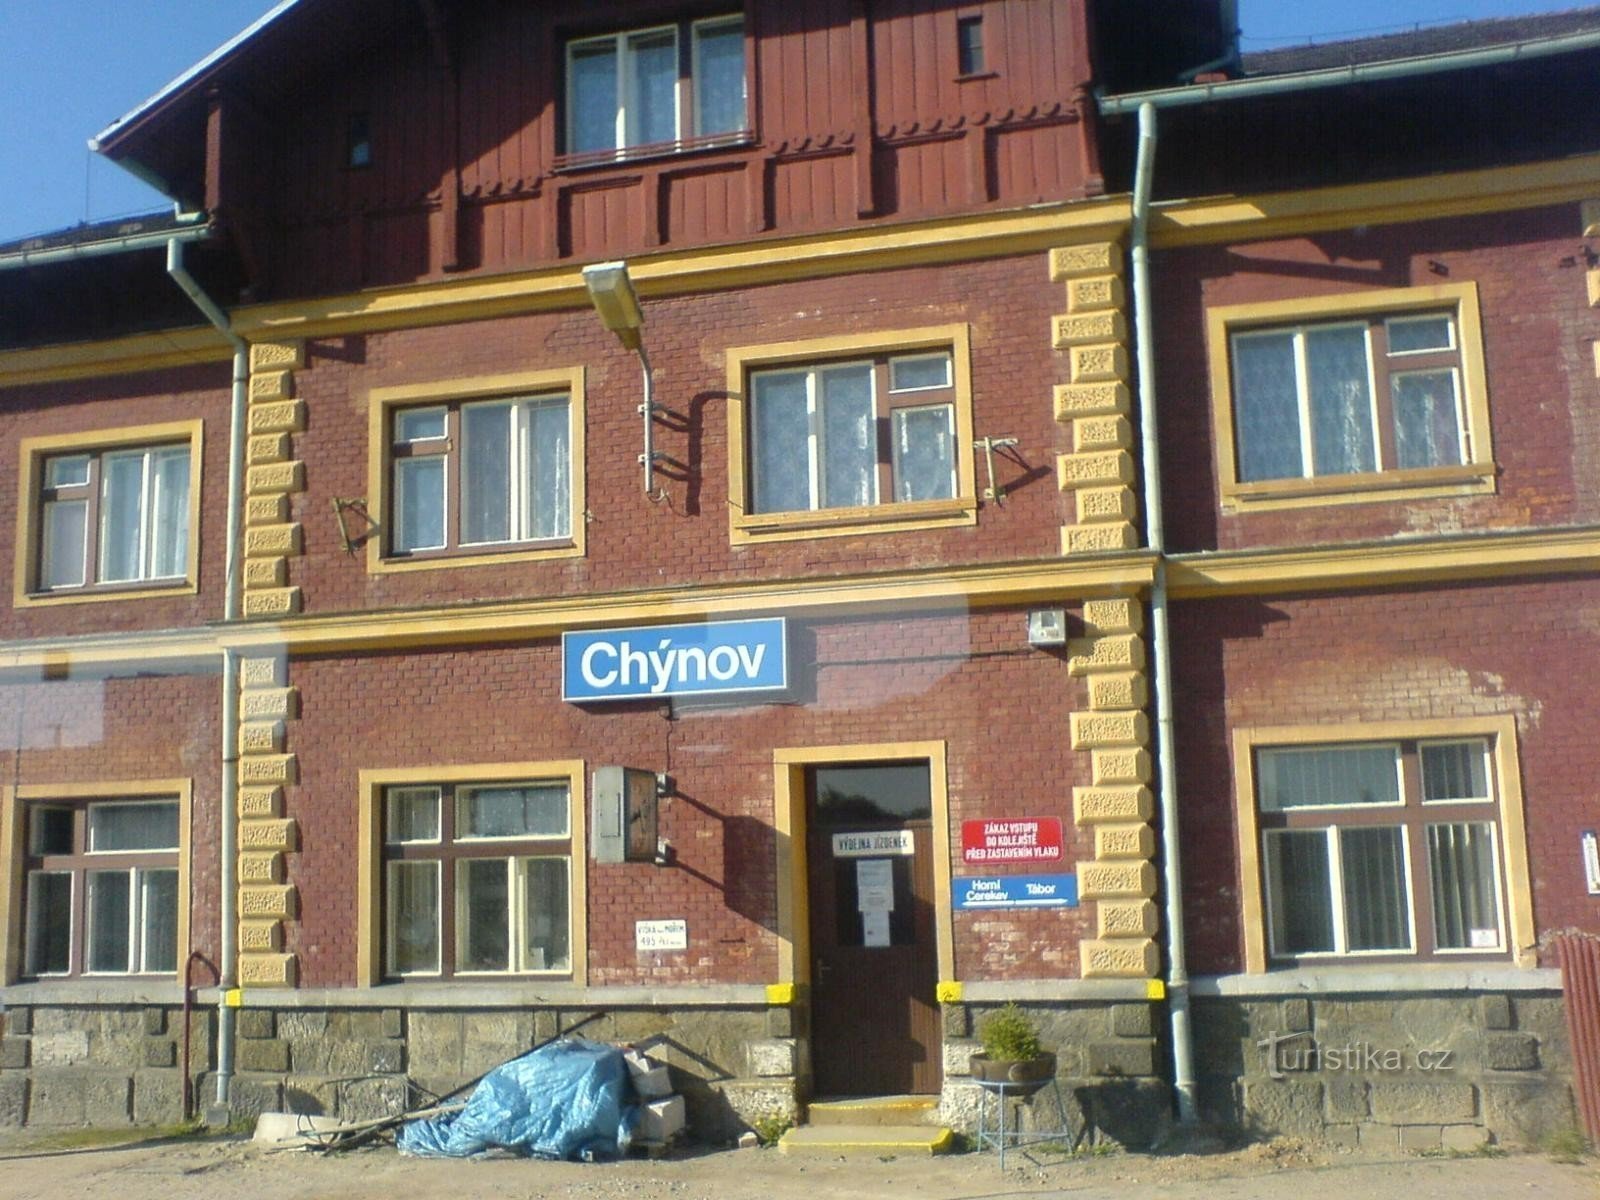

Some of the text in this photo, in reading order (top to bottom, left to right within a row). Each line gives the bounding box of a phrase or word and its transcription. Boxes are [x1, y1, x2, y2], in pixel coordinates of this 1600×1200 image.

[581, 639, 766, 693] Chýnov
[1010, 822, 1038, 833] VSTUPU
[986, 835, 997, 846] DO
[1034, 846, 1059, 857] VLAKU
[1026, 883, 1056, 894] Tábor
